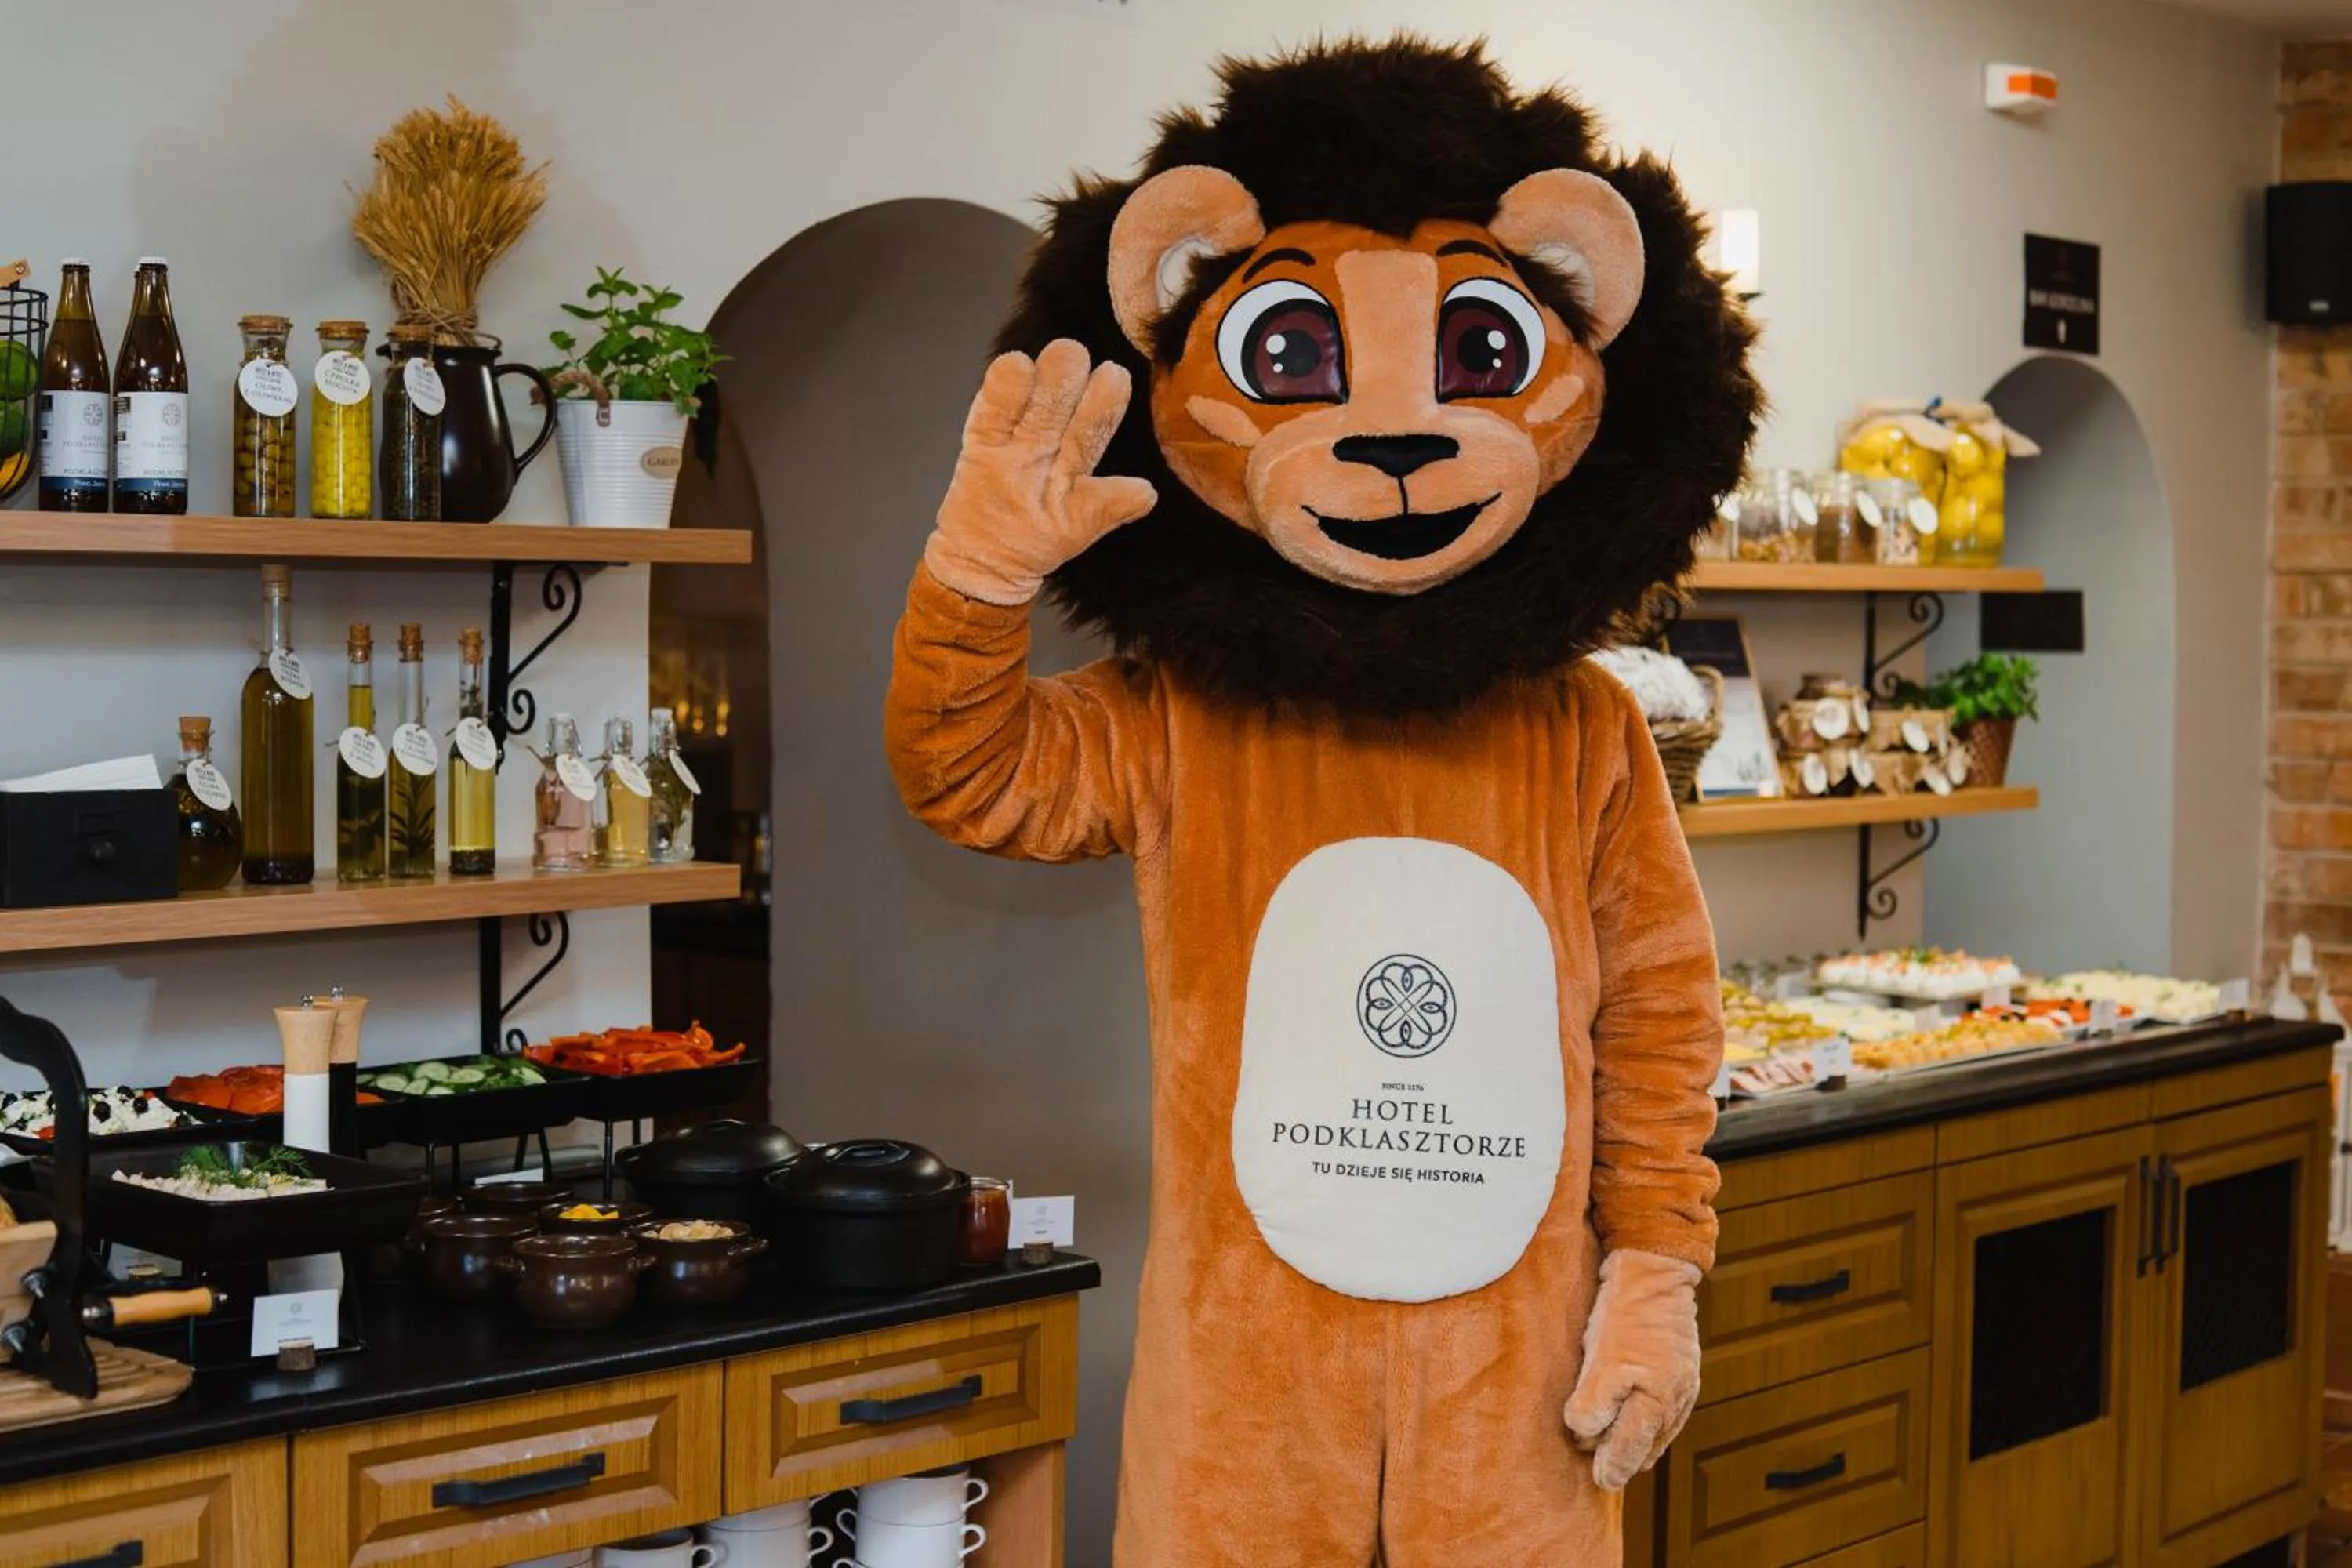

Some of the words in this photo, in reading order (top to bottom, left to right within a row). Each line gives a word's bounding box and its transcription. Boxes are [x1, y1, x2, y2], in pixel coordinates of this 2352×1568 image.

[1352, 1098, 1453, 1125] HOTEL
[1272, 1122, 1525, 1158] PODKLASZTORZE
[1312, 1161, 1330, 1174] TU
[1335, 1163, 1387, 1178] DZIEJE
[1391, 1167, 1413, 1183] SIĘ
[1417, 1169, 1485, 1185] HISTORIA
